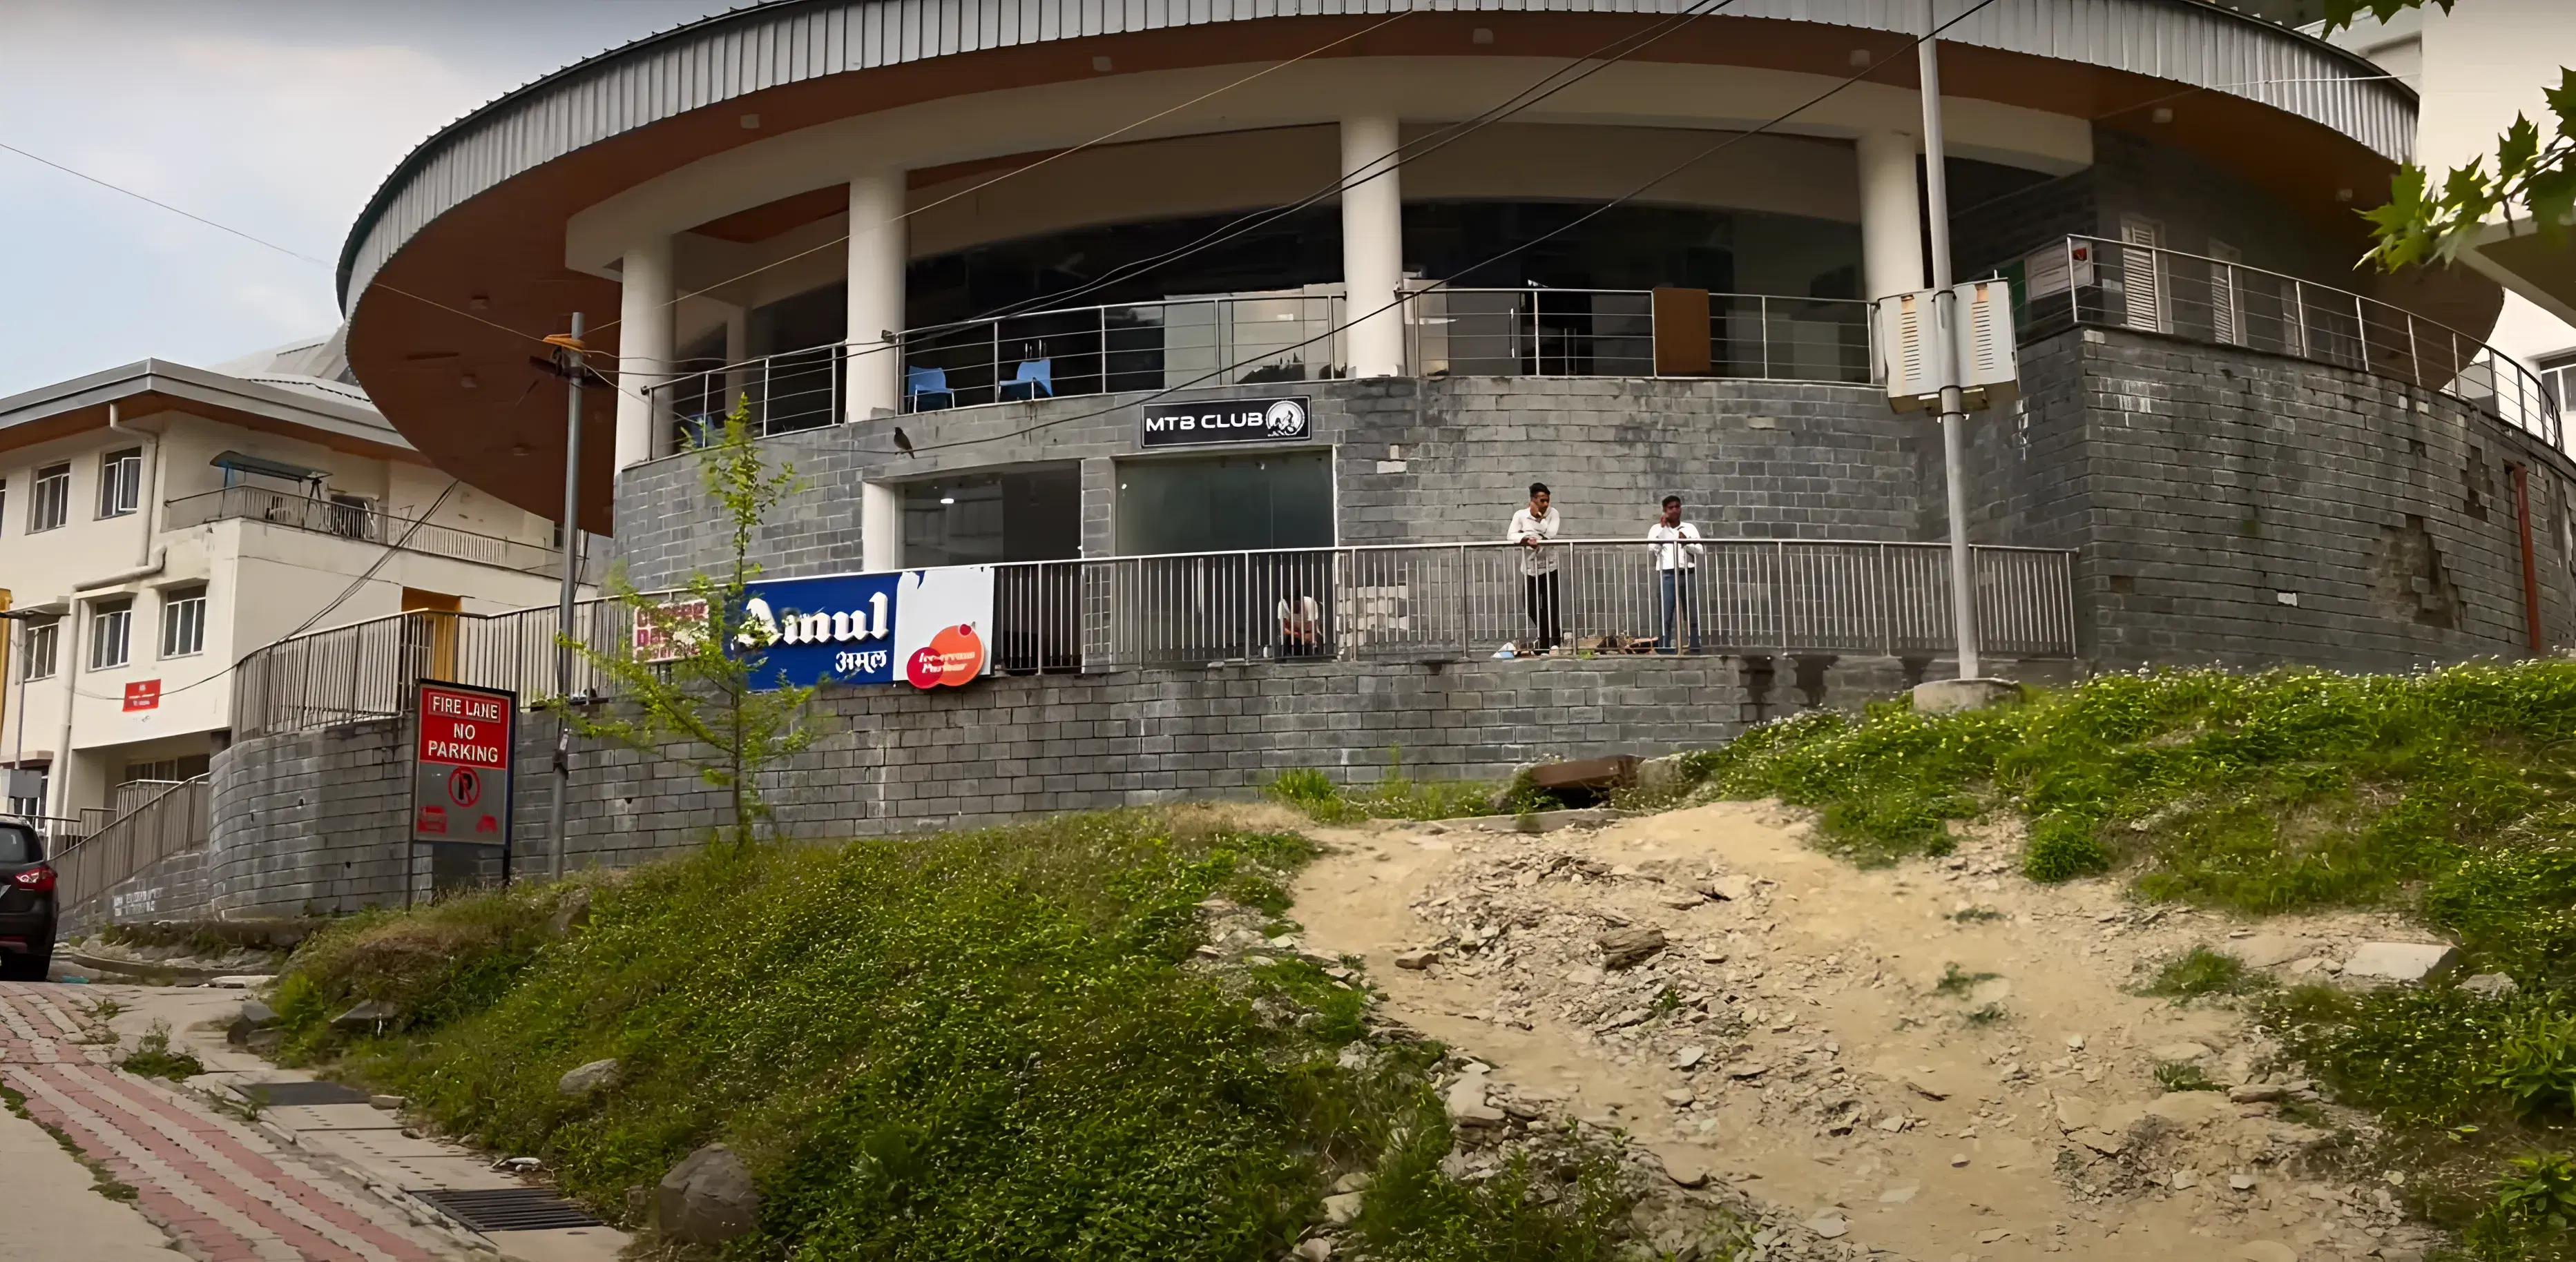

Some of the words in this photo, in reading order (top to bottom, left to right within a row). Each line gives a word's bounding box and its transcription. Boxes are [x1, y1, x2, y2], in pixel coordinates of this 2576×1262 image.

[1146, 416, 1195, 431] MTB
[1201, 412, 1262, 428] CLUB
[731, 591, 890, 650] Amul
[433, 696, 461, 714] FIRE
[466, 700, 498, 719] LANE
[454, 723, 476, 740] NO
[428, 739, 498, 763] PARKING
